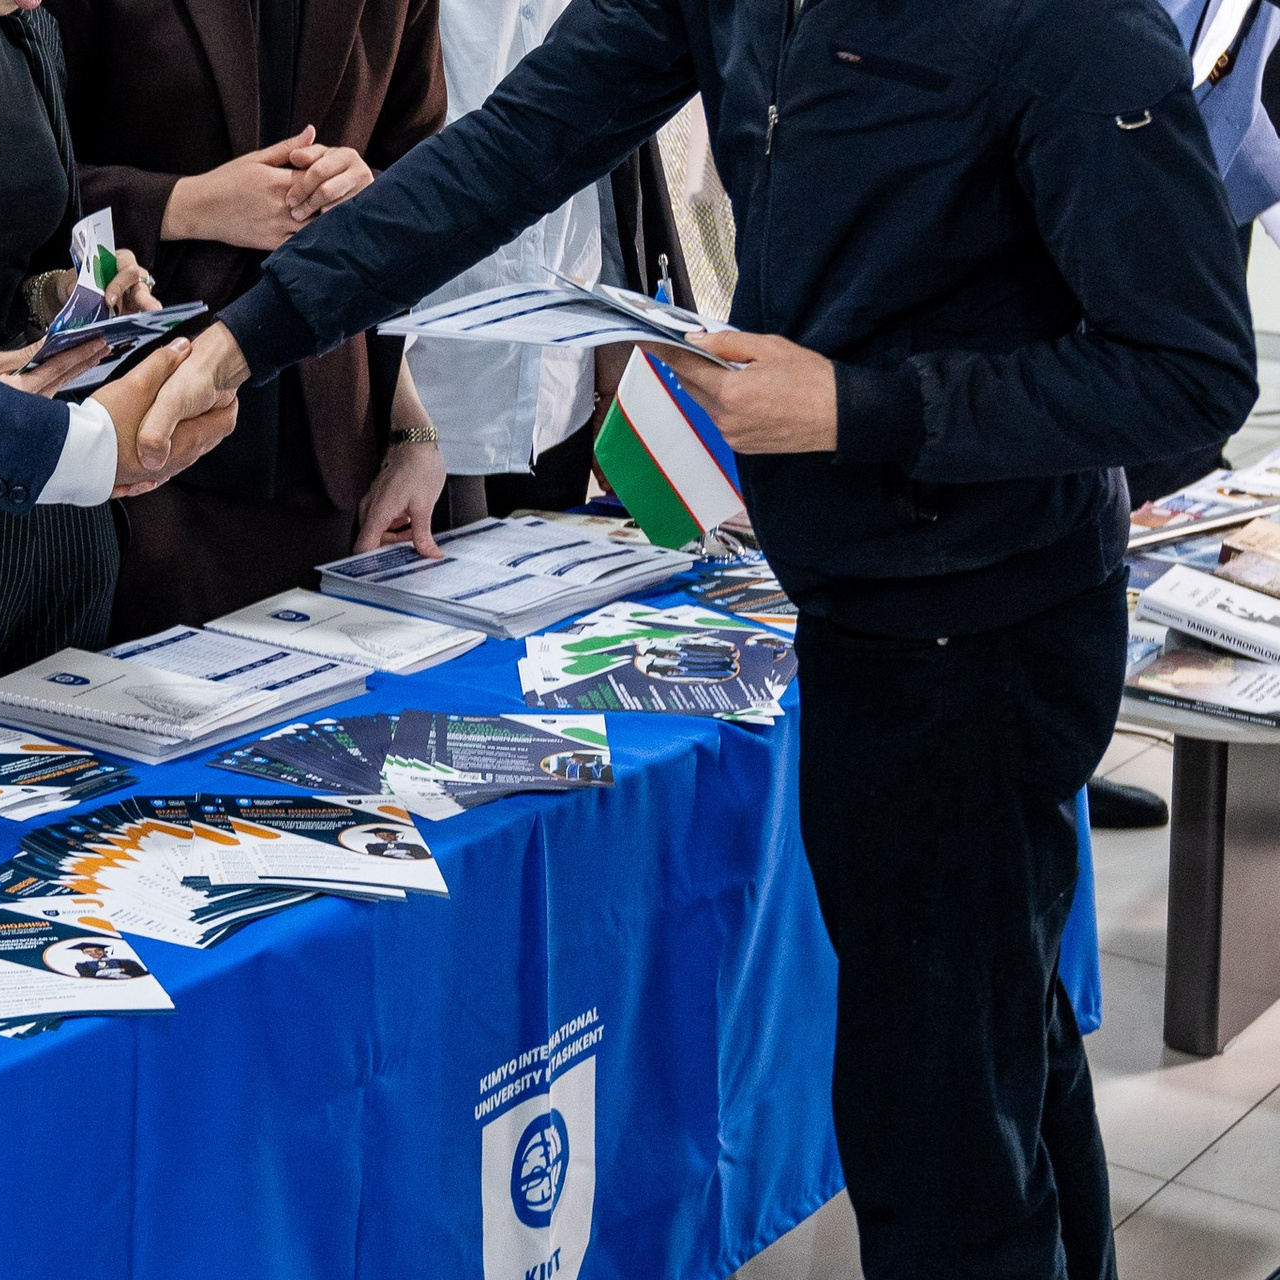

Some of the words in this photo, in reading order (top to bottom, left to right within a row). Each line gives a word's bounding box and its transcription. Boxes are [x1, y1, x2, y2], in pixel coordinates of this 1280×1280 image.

[1186, 619, 1218, 638] TARIXIY
[474, 1068, 542, 1120] UNIVERSITY
[551, 1024, 605, 1072] TASHKENT
[480, 1059, 517, 1094] KIMYO
[518, 1006, 599, 1070] INTENATIONAL
